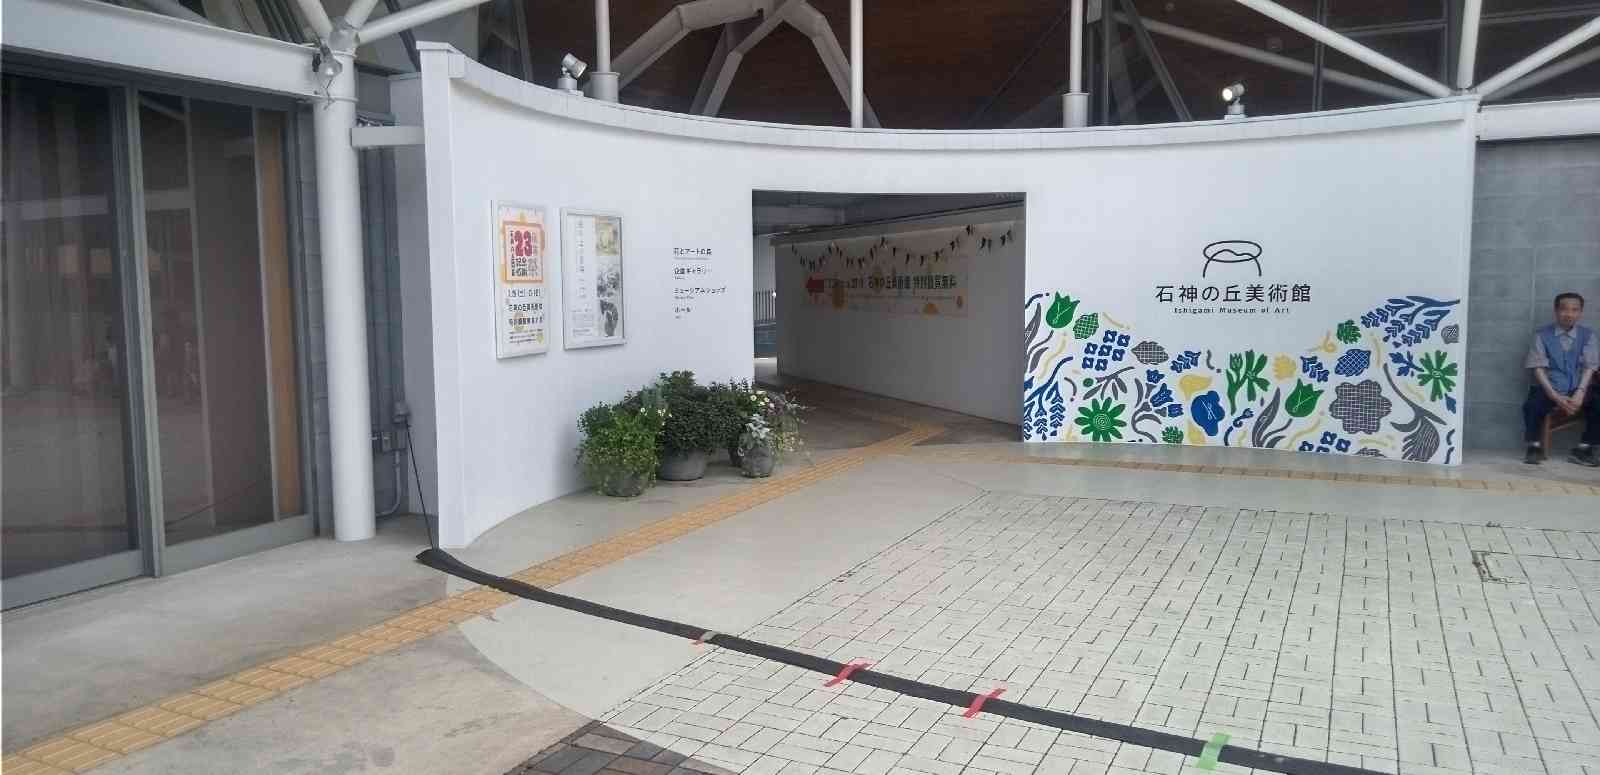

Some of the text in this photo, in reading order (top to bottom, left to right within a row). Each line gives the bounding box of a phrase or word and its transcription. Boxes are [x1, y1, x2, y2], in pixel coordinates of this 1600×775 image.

[514, 230, 533, 257] 23
[1155, 283, 1312, 303] 石神の丘美術館
[1174, 306, 1214, 315] Ishigami
[1219, 306, 1256, 314] Museum
[1274, 306, 1290, 314] Art
